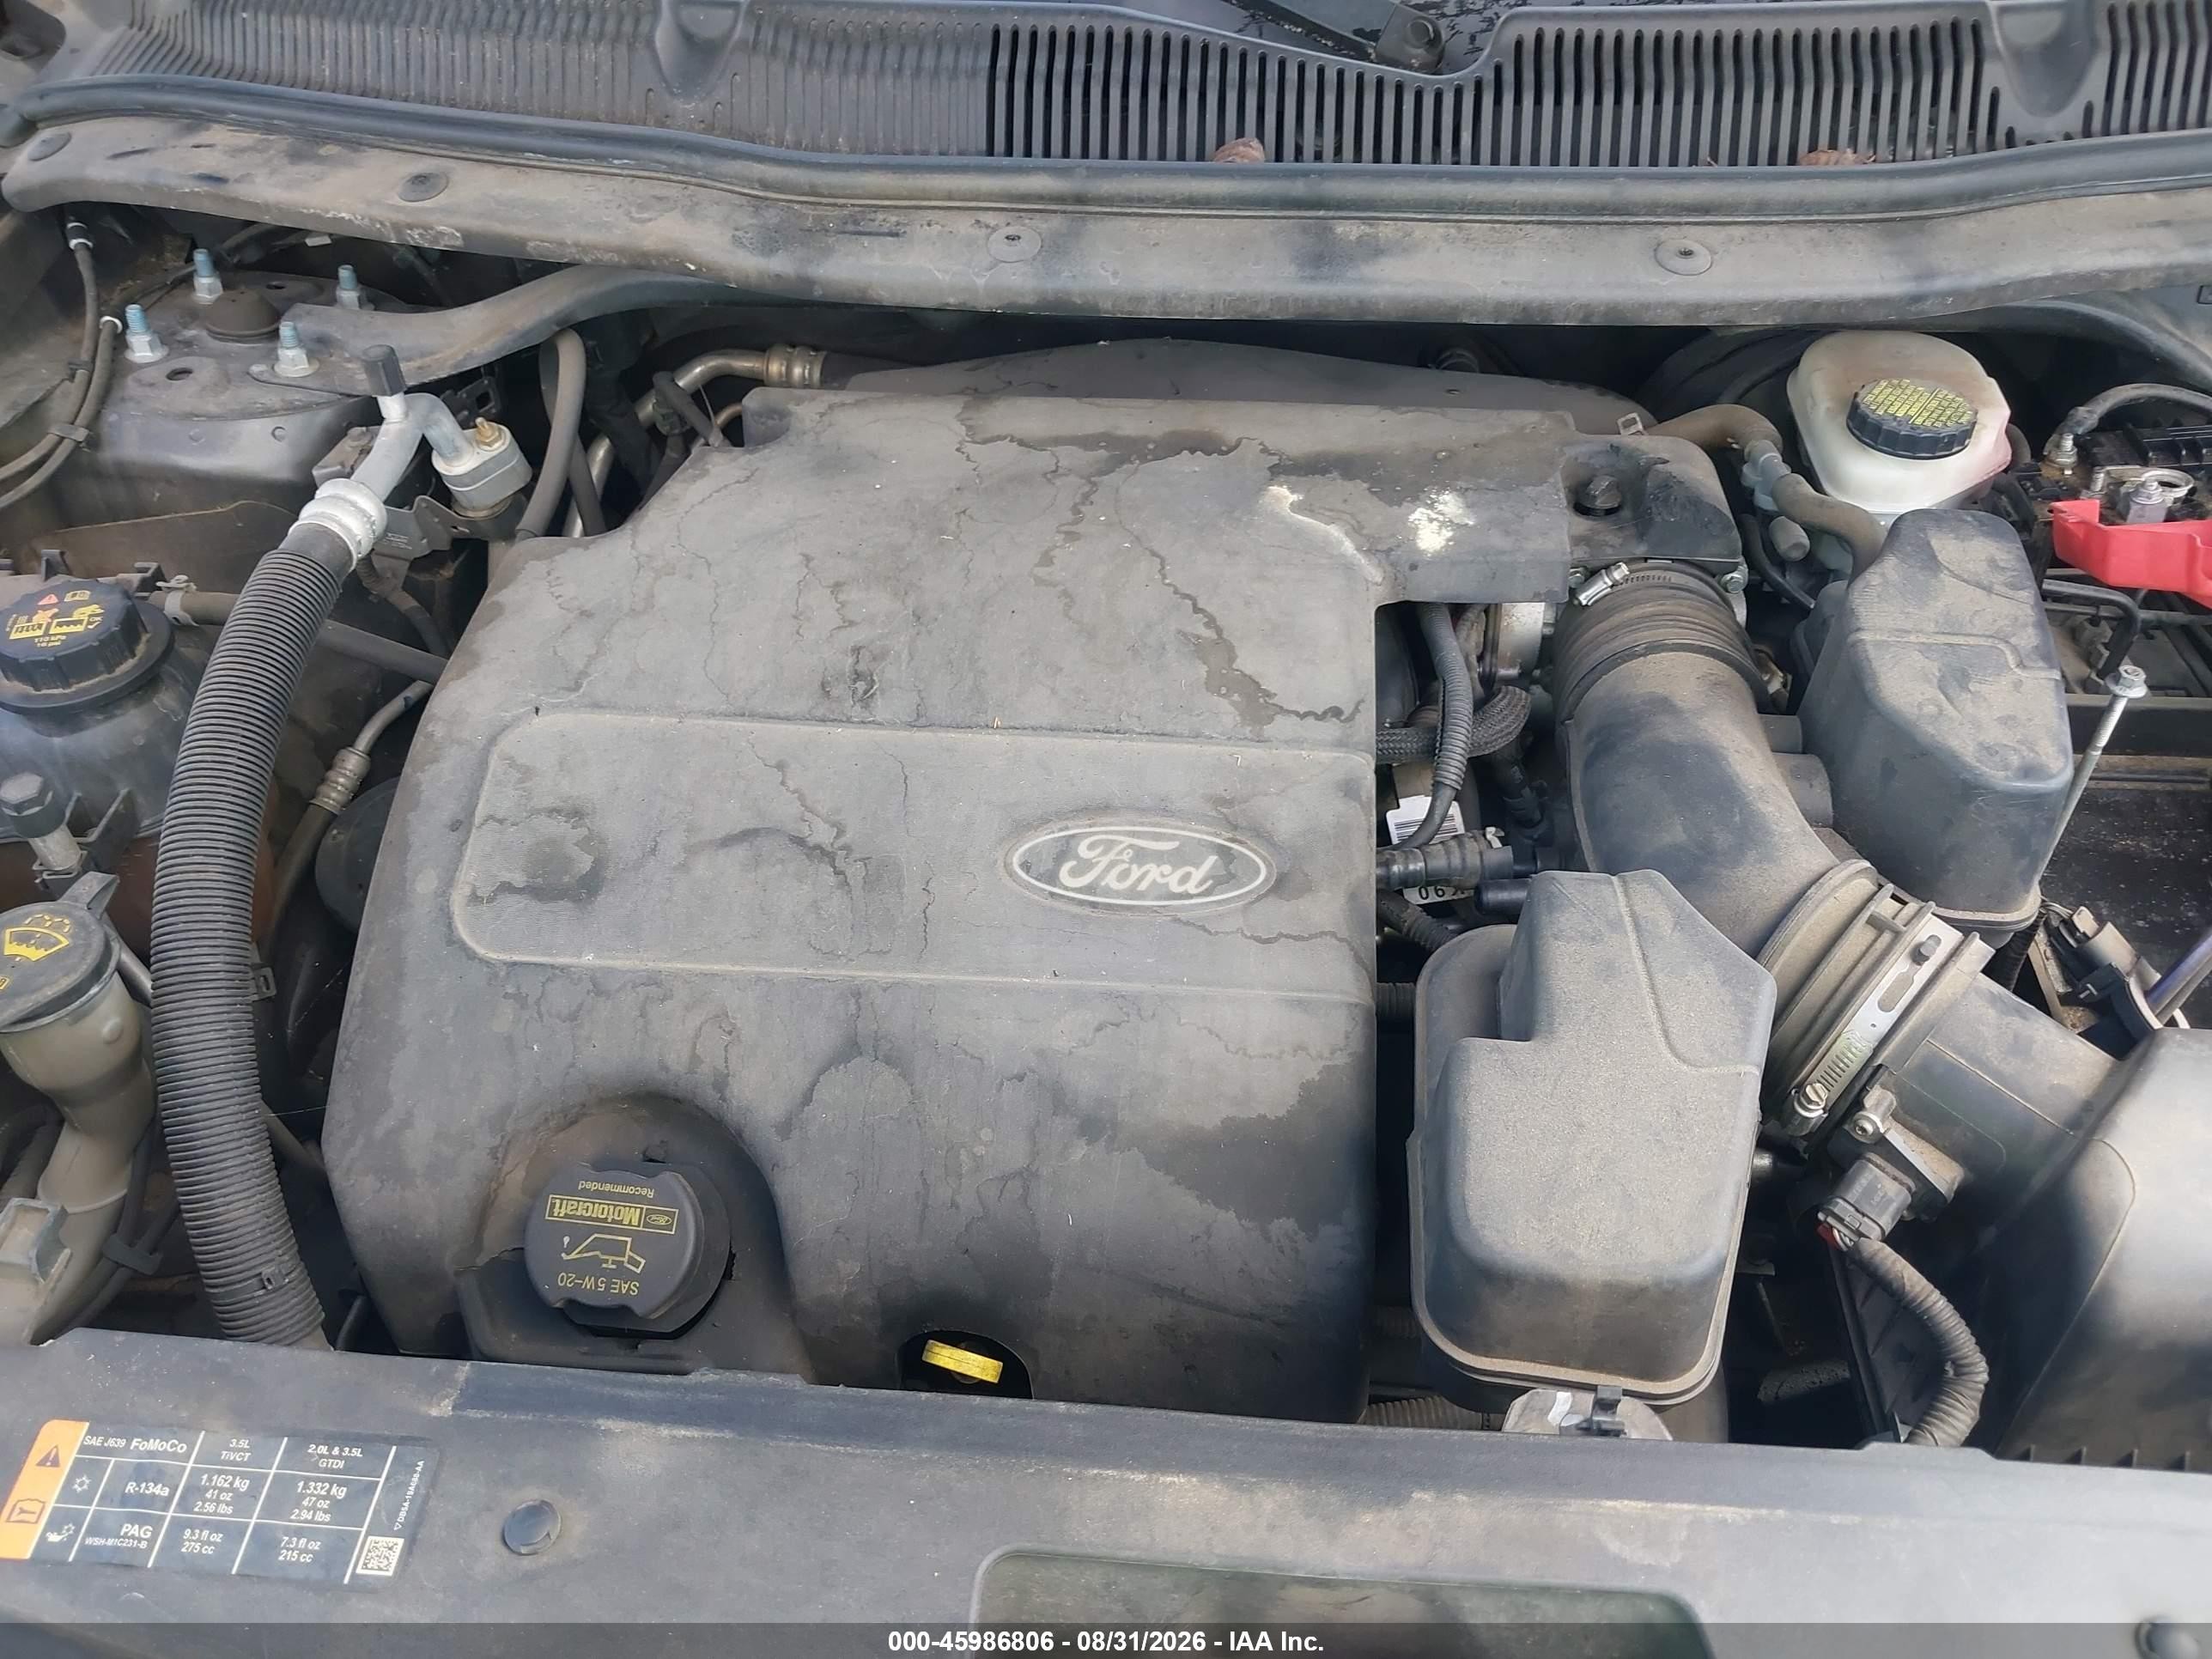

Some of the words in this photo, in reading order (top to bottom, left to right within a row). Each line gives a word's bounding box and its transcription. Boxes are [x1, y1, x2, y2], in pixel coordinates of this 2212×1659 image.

[1059, 835, 1218, 895] Ford
[578, 1181, 654, 1199] Recommended
[552, 1199, 641, 1226] Motorcraft
[558, 1272, 605, 1292] 5W-20
[611, 1279, 639, 1296] SAE
[83, 1436, 104, 1446] SAE
[104, 1437, 126, 1448] J639
[130, 1438, 187, 1453] FoMoCo
[229, 1438, 250, 1449] 3.5L
[307, 1444, 329, 1455] 2.0L
[331, 1447, 340, 1455] &
[342, 1448, 363, 1457] 3.5L
[319, 1459, 345, 1469] GTDI
[125, 1481, 170, 1497] R-134a
[201, 1474, 233, 1488] 1.162
[233, 1476, 250, 1492] kg
[296, 1481, 329, 1495] 1.332
[330, 1484, 348, 1499] kg
[205, 1489, 218, 1499] 41
[219, 1492, 233, 1501] oz
[193, 1501, 216, 1513] 2.56
[216, 1503, 234, 1515] lbs
[301, 1497, 316, 1507] 47
[316, 1500, 330, 1509] oz
[290, 1509, 313, 1521] 2.94
[314, 1511, 331, 1522] lbs
[120, 1523, 153, 1539] PAG
[183, 1528, 200, 1540] 9.3
[210, 1533, 223, 1542] oz
[180, 1541, 201, 1553] 275
[201, 1546, 215, 1554] cc
[281, 1536, 297, 1547] 7.3
[307, 1540, 321, 1550] oz
[278, 1550, 299, 1561] 215
[300, 1553, 313, 1563] cc
